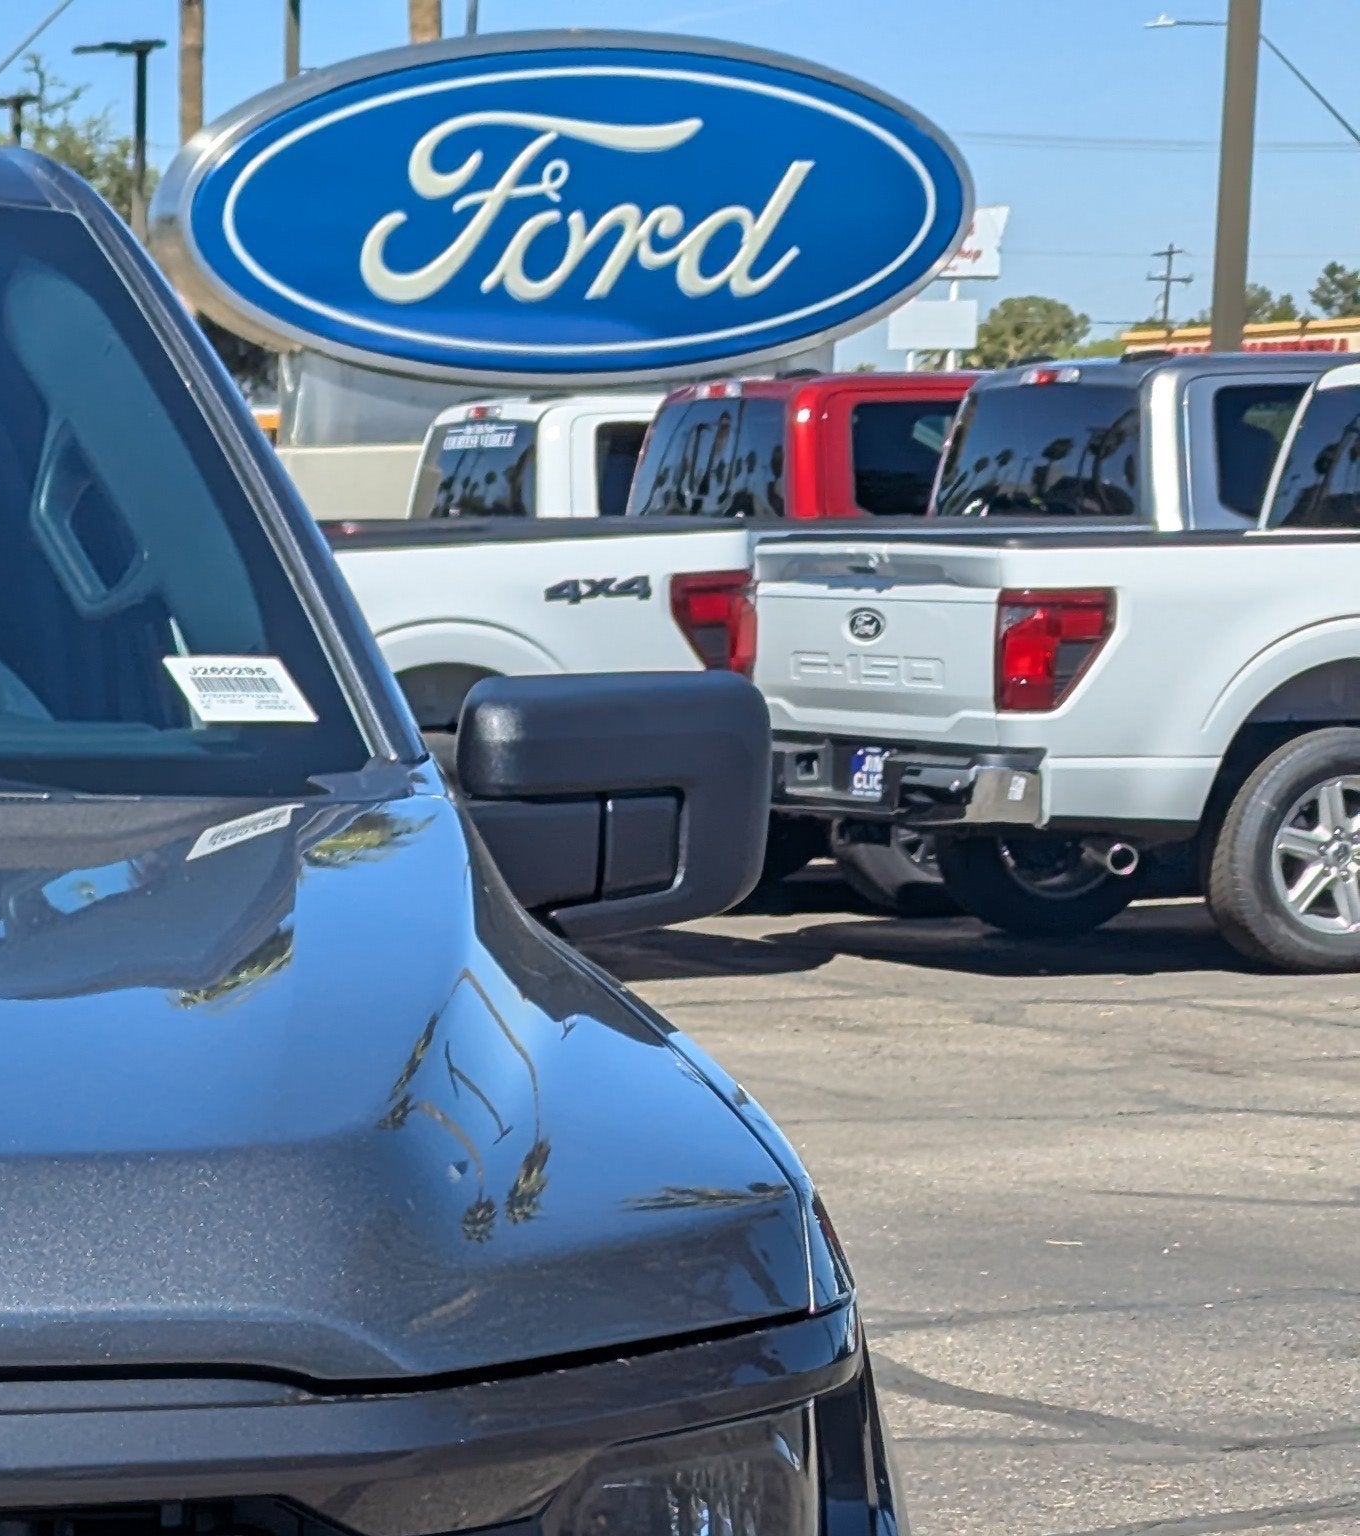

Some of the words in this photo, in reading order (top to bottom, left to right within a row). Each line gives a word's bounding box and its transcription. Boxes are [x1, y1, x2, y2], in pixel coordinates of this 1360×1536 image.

[360, 110, 816, 304] Ford
[791, 650, 945, 690] F-150
[853, 772, 883, 791] CLIC
